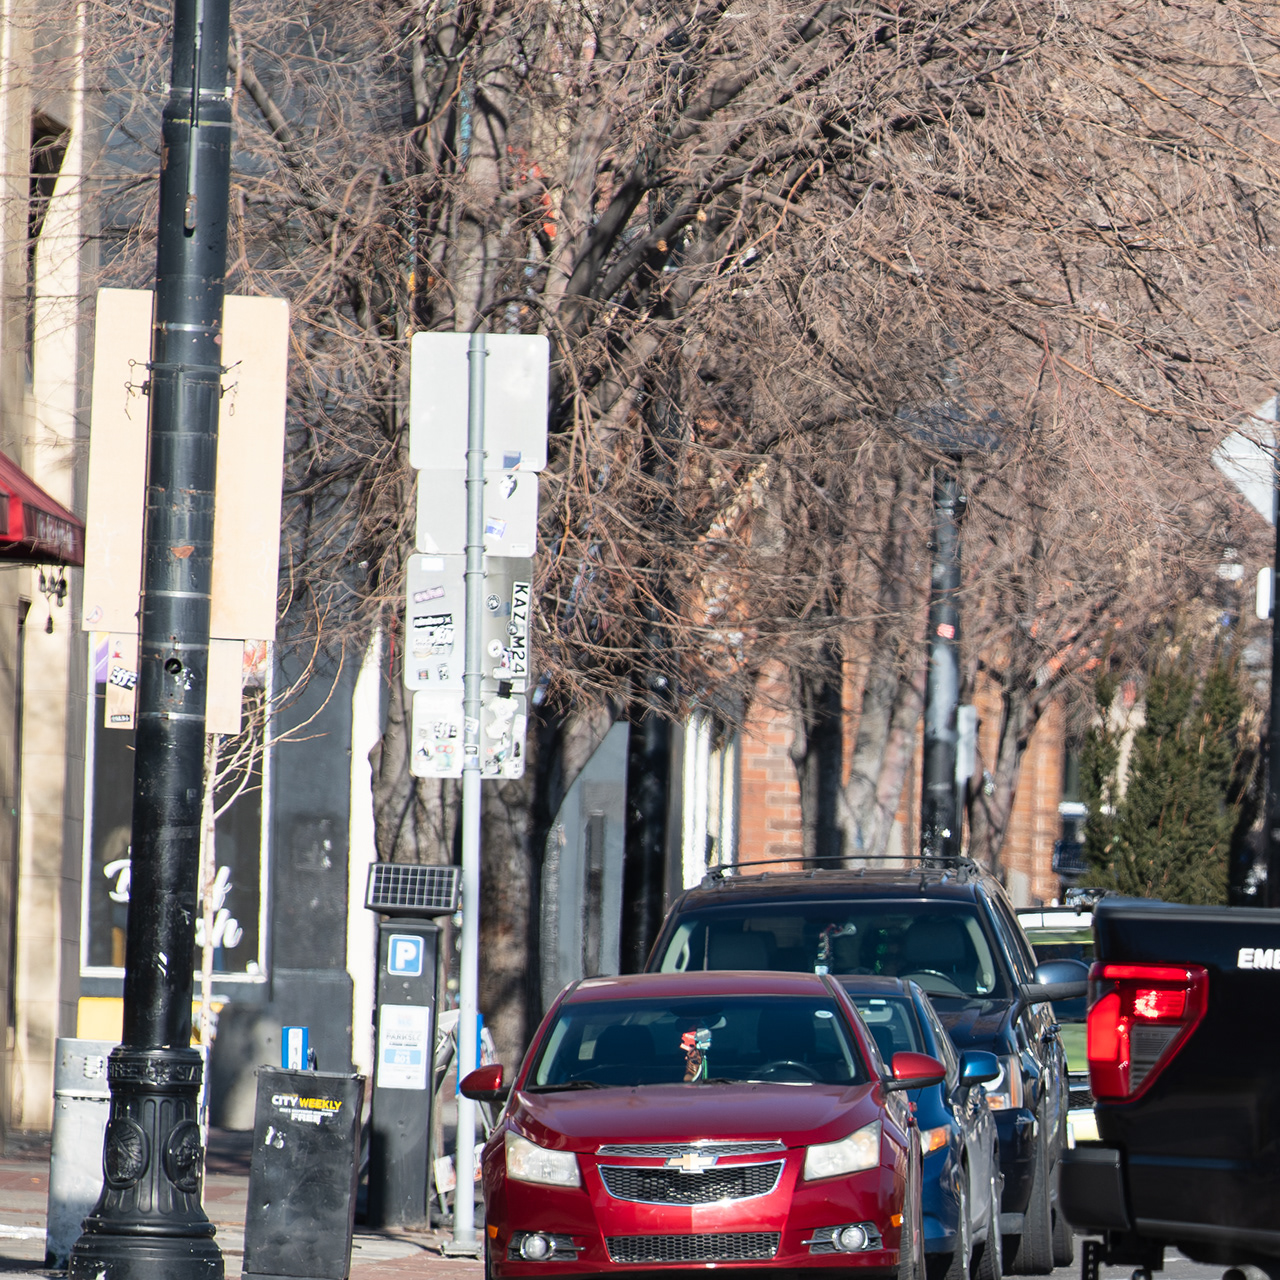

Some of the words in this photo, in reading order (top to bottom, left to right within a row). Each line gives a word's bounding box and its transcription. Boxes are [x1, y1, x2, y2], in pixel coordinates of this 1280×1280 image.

[396, 940, 417, 971] P
[271, 1094, 298, 1107] CITY
[299, 1097, 342, 1111] WEEKLY
